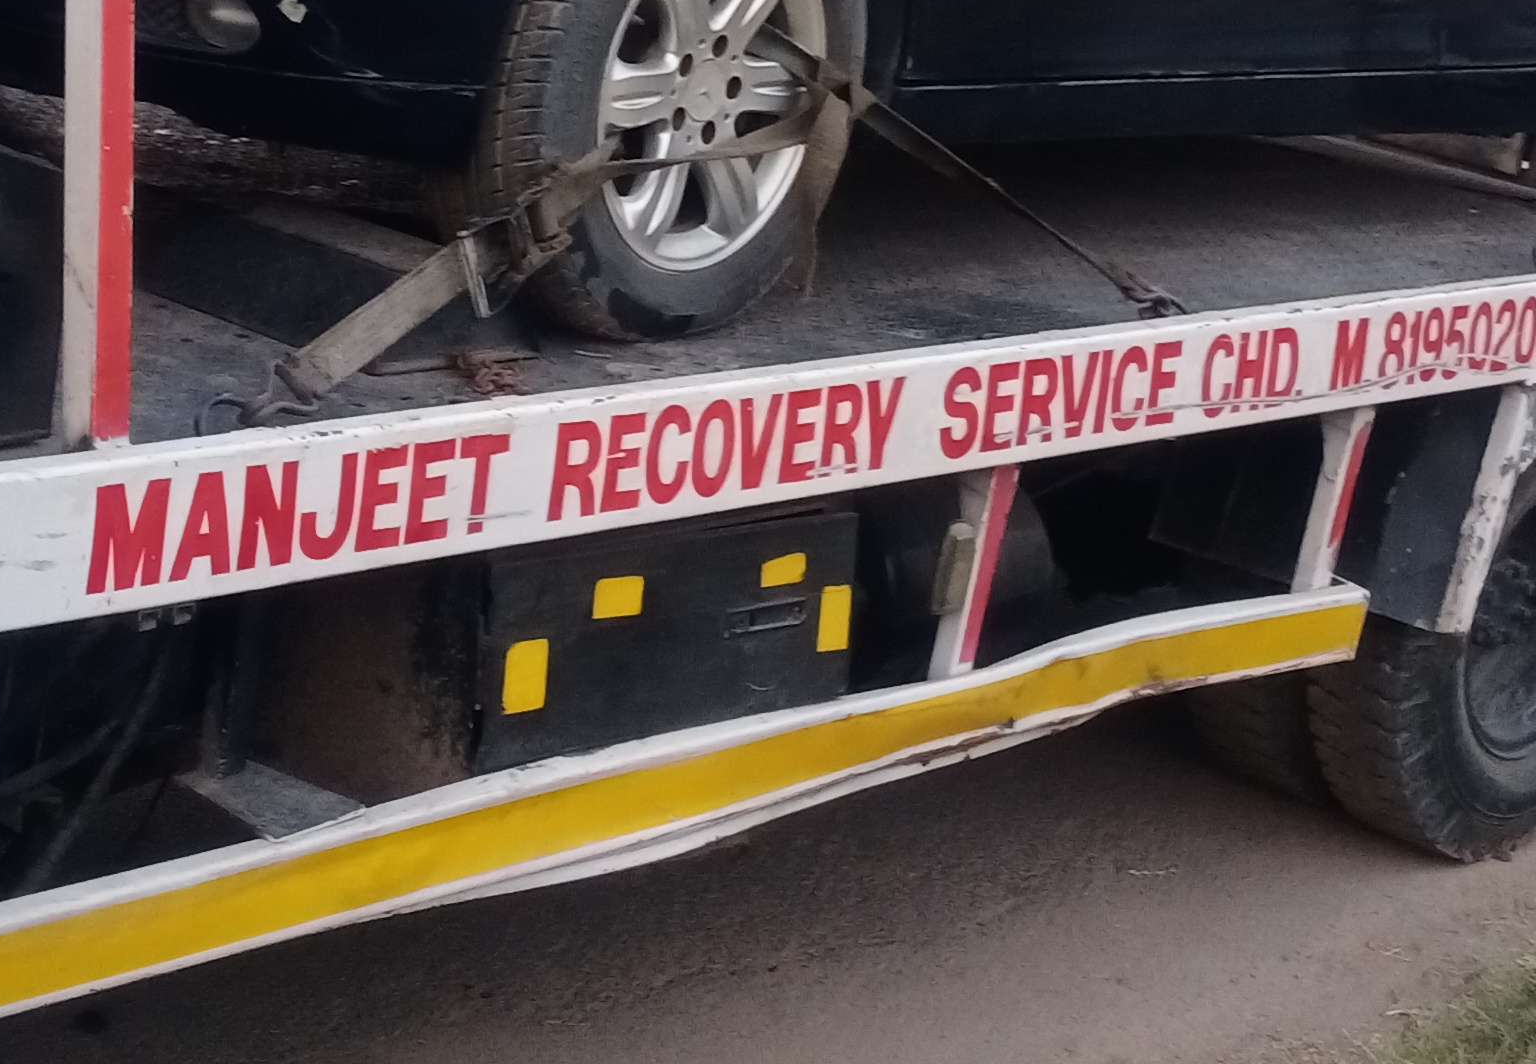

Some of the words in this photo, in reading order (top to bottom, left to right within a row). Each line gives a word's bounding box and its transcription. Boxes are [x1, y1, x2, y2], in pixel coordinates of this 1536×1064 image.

[85, 432, 512, 596] MANJEET
[546, 376, 907, 523] RECOVERY
[939, 340, 1184, 460] SERVICE
